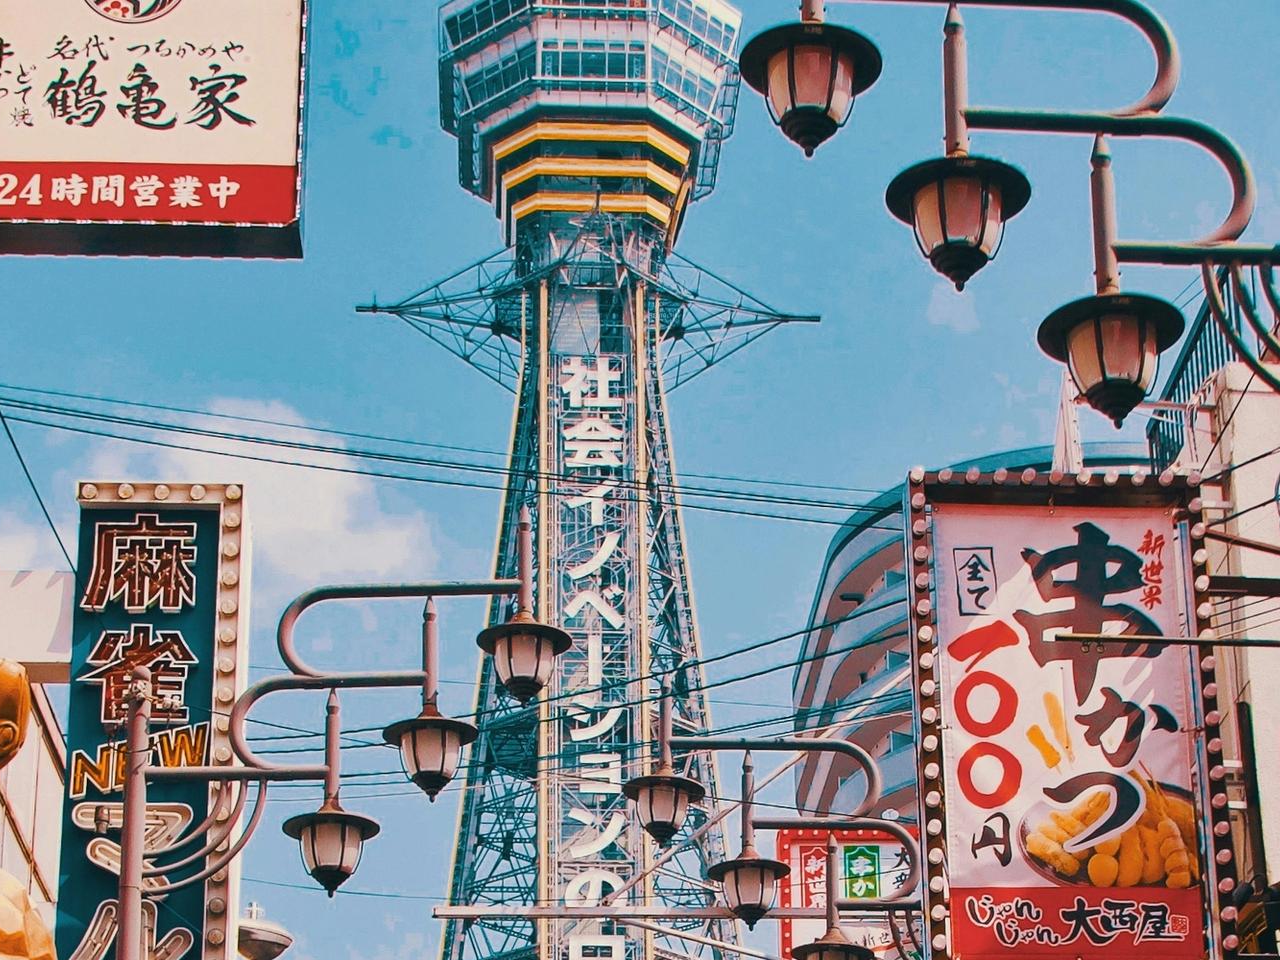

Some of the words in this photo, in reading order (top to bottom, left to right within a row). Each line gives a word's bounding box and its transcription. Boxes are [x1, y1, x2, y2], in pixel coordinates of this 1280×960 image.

[45, 34, 116, 61] 名代
[126, 39, 245, 62] つるかめや
[44, 60, 257, 130] 鶴亀家
[958, 553, 991, 612] 全て
[1137, 529, 1165, 610] 新世界
[74, 512, 199, 724] 麻雀
[1013, 520, 1179, 852] 串かつ
[70, 722, 211, 800] NEW
